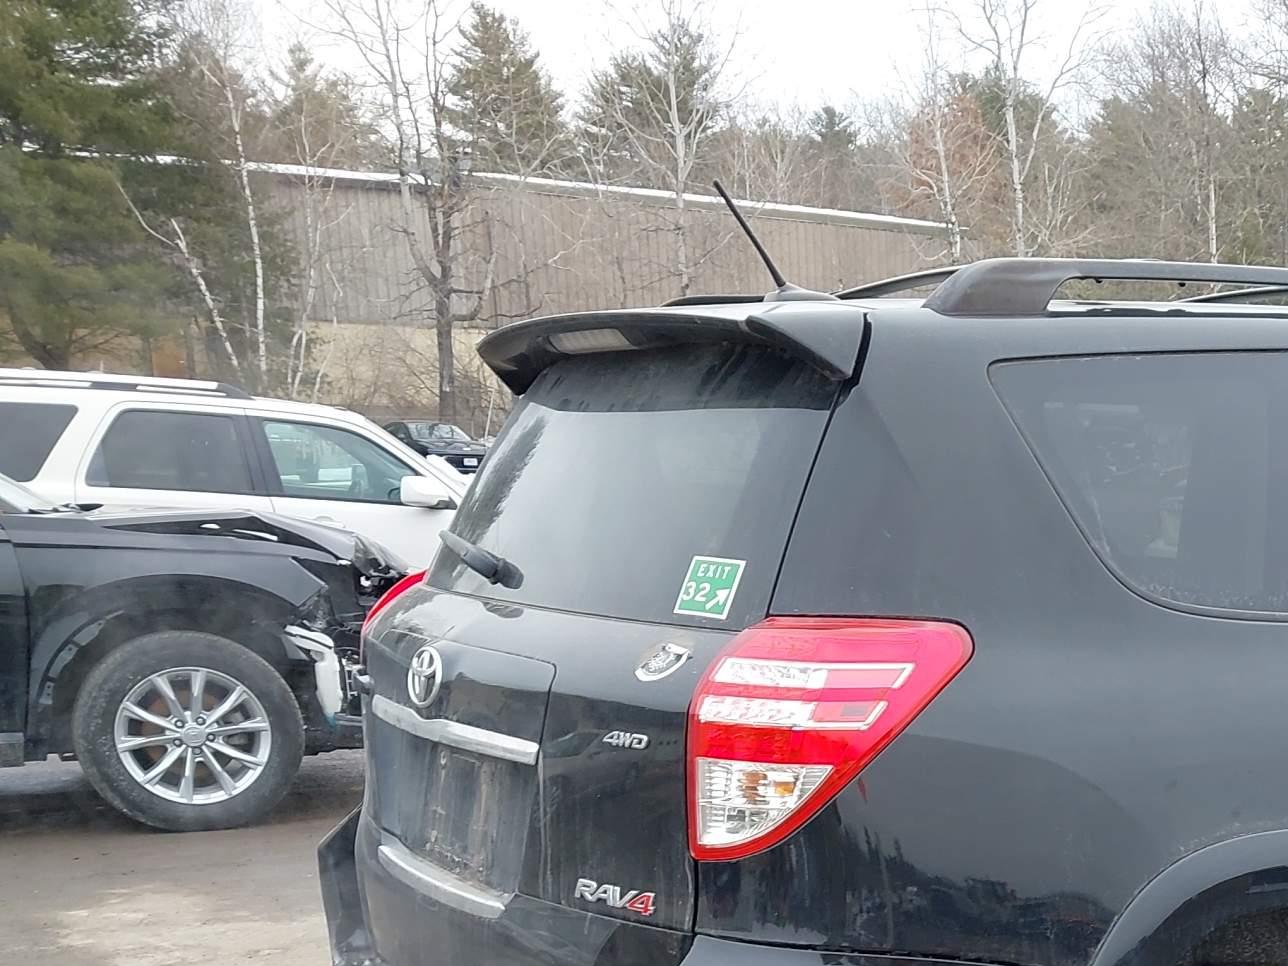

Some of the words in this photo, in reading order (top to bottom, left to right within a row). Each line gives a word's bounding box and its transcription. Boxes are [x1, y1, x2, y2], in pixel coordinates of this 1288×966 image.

[696, 563, 732, 580] EXIT
[682, 581, 711, 602] 32
[602, 730, 650, 750] 4WD
[574, 878, 657, 917] RAV4
